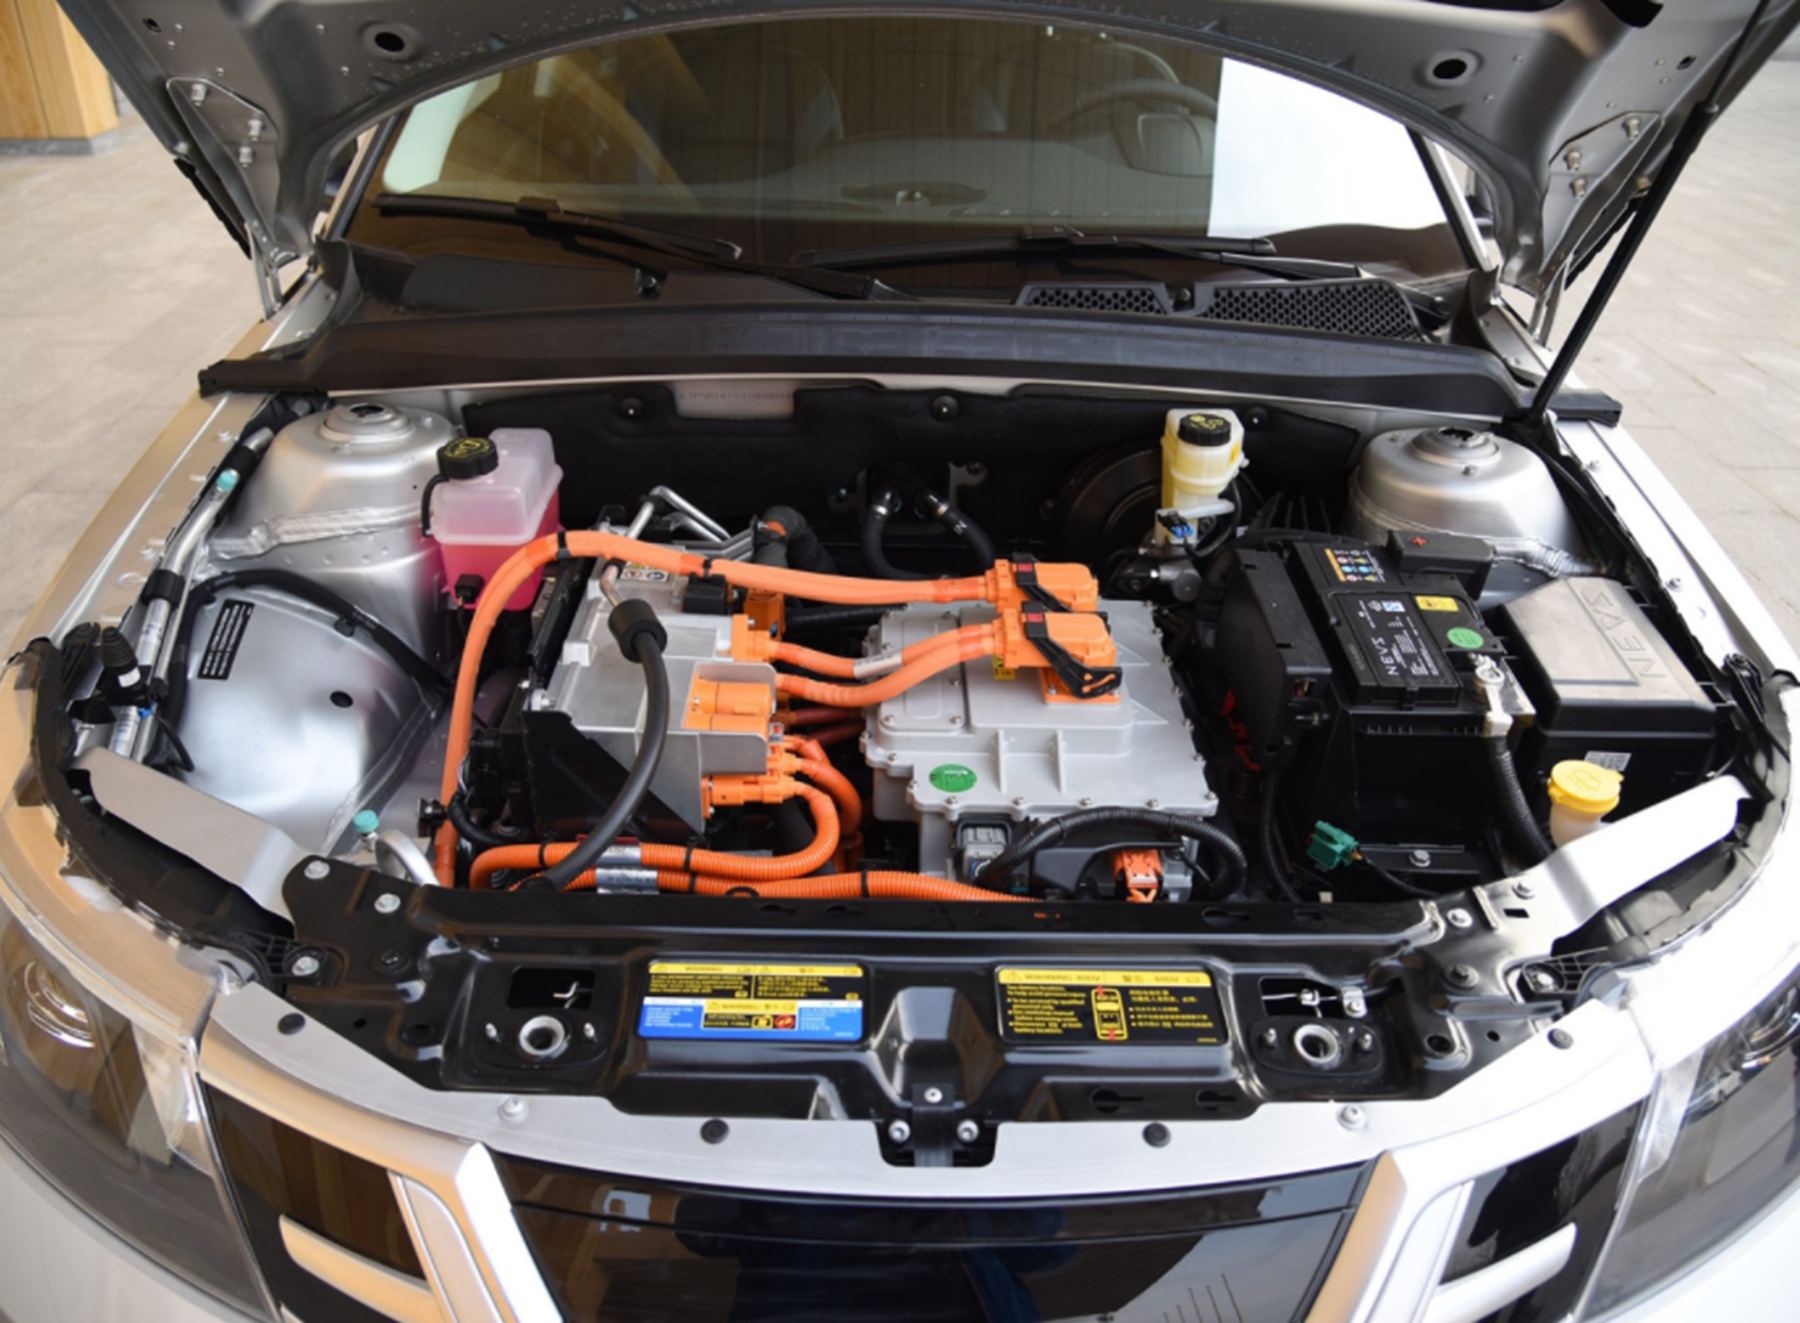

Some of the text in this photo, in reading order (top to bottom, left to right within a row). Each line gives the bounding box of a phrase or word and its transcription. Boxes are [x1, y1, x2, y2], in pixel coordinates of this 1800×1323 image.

[1579, 591, 1667, 677] NEVS
[1371, 637, 1400, 675] NEVS
[1023, 973, 1073, 981] WARNING
